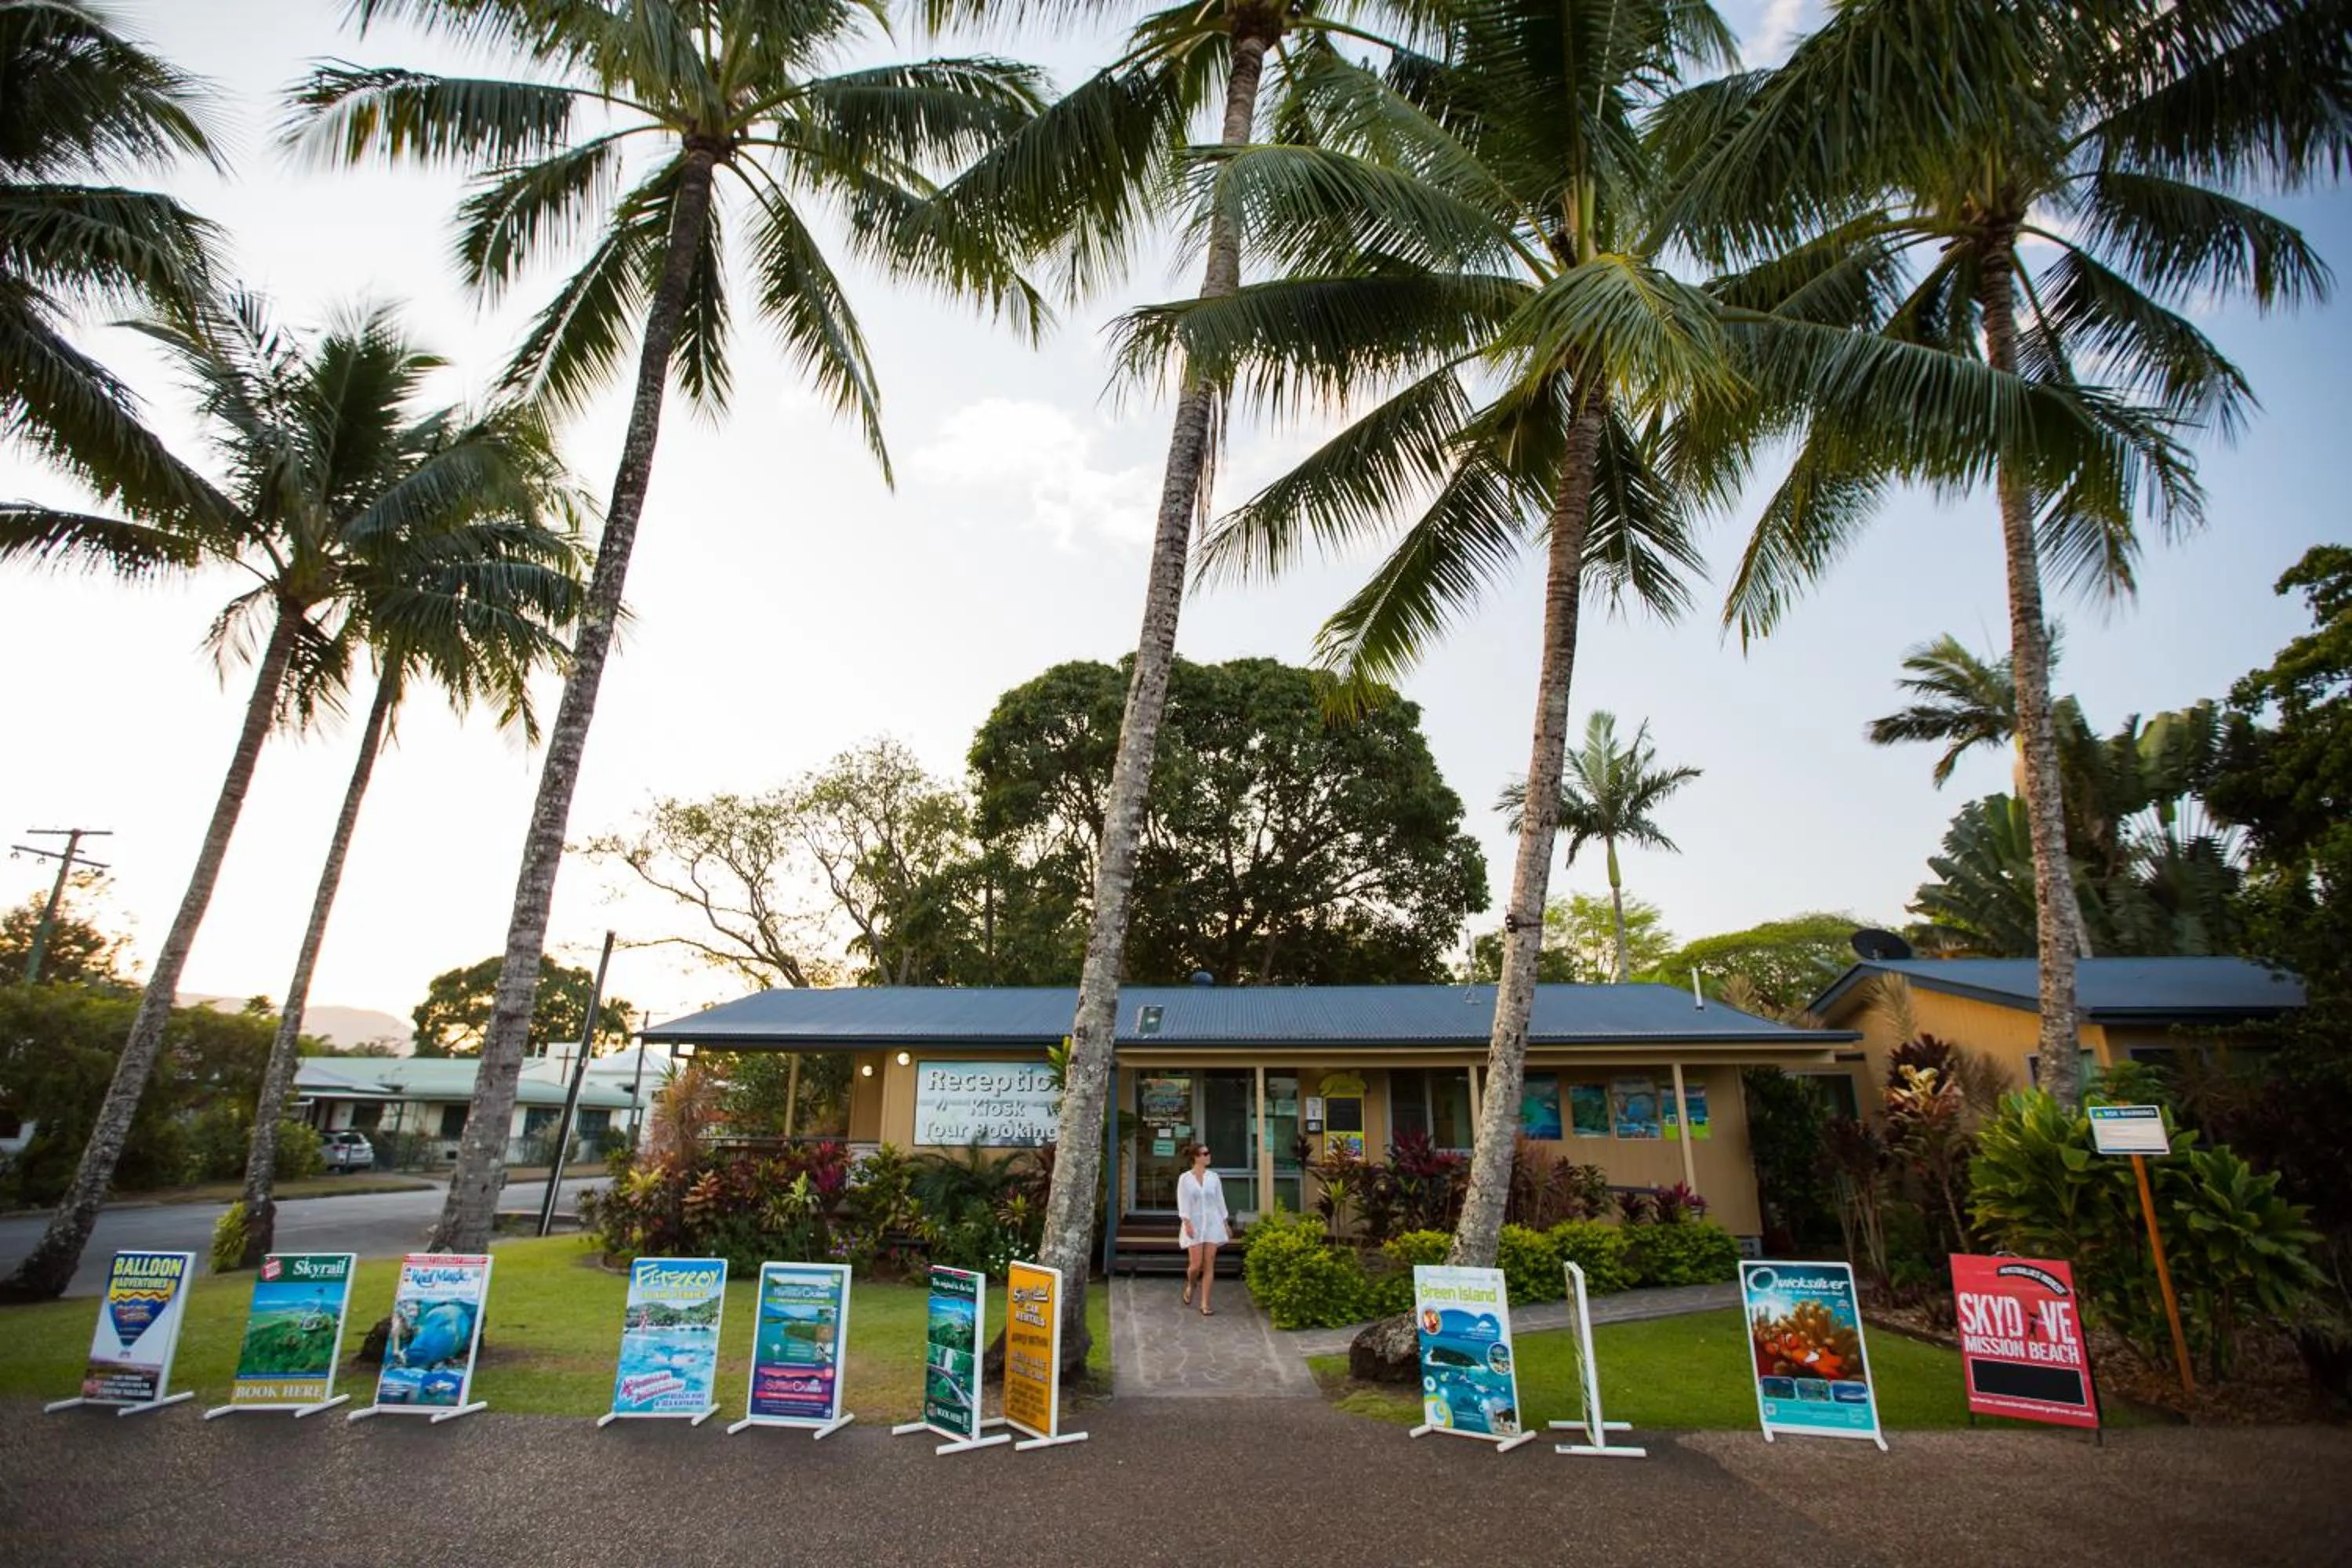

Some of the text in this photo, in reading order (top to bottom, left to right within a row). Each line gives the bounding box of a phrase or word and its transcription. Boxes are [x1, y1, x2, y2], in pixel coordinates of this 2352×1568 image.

[927, 1067, 1062, 1098] Receptio
[971, 1099, 1025, 1117] Kiosk
[927, 1121, 968, 1139] Tour
[113, 1257, 183, 1277] BALLOON
[292, 1256, 347, 1279] Skyrail
[1747, 1267, 1849, 1292] Quicksilver
[1421, 1284, 1497, 1302] Green Island
[1964, 1335, 2081, 1364] MISSION BEACH
[236, 1385, 325, 1398] BOOK HERE
